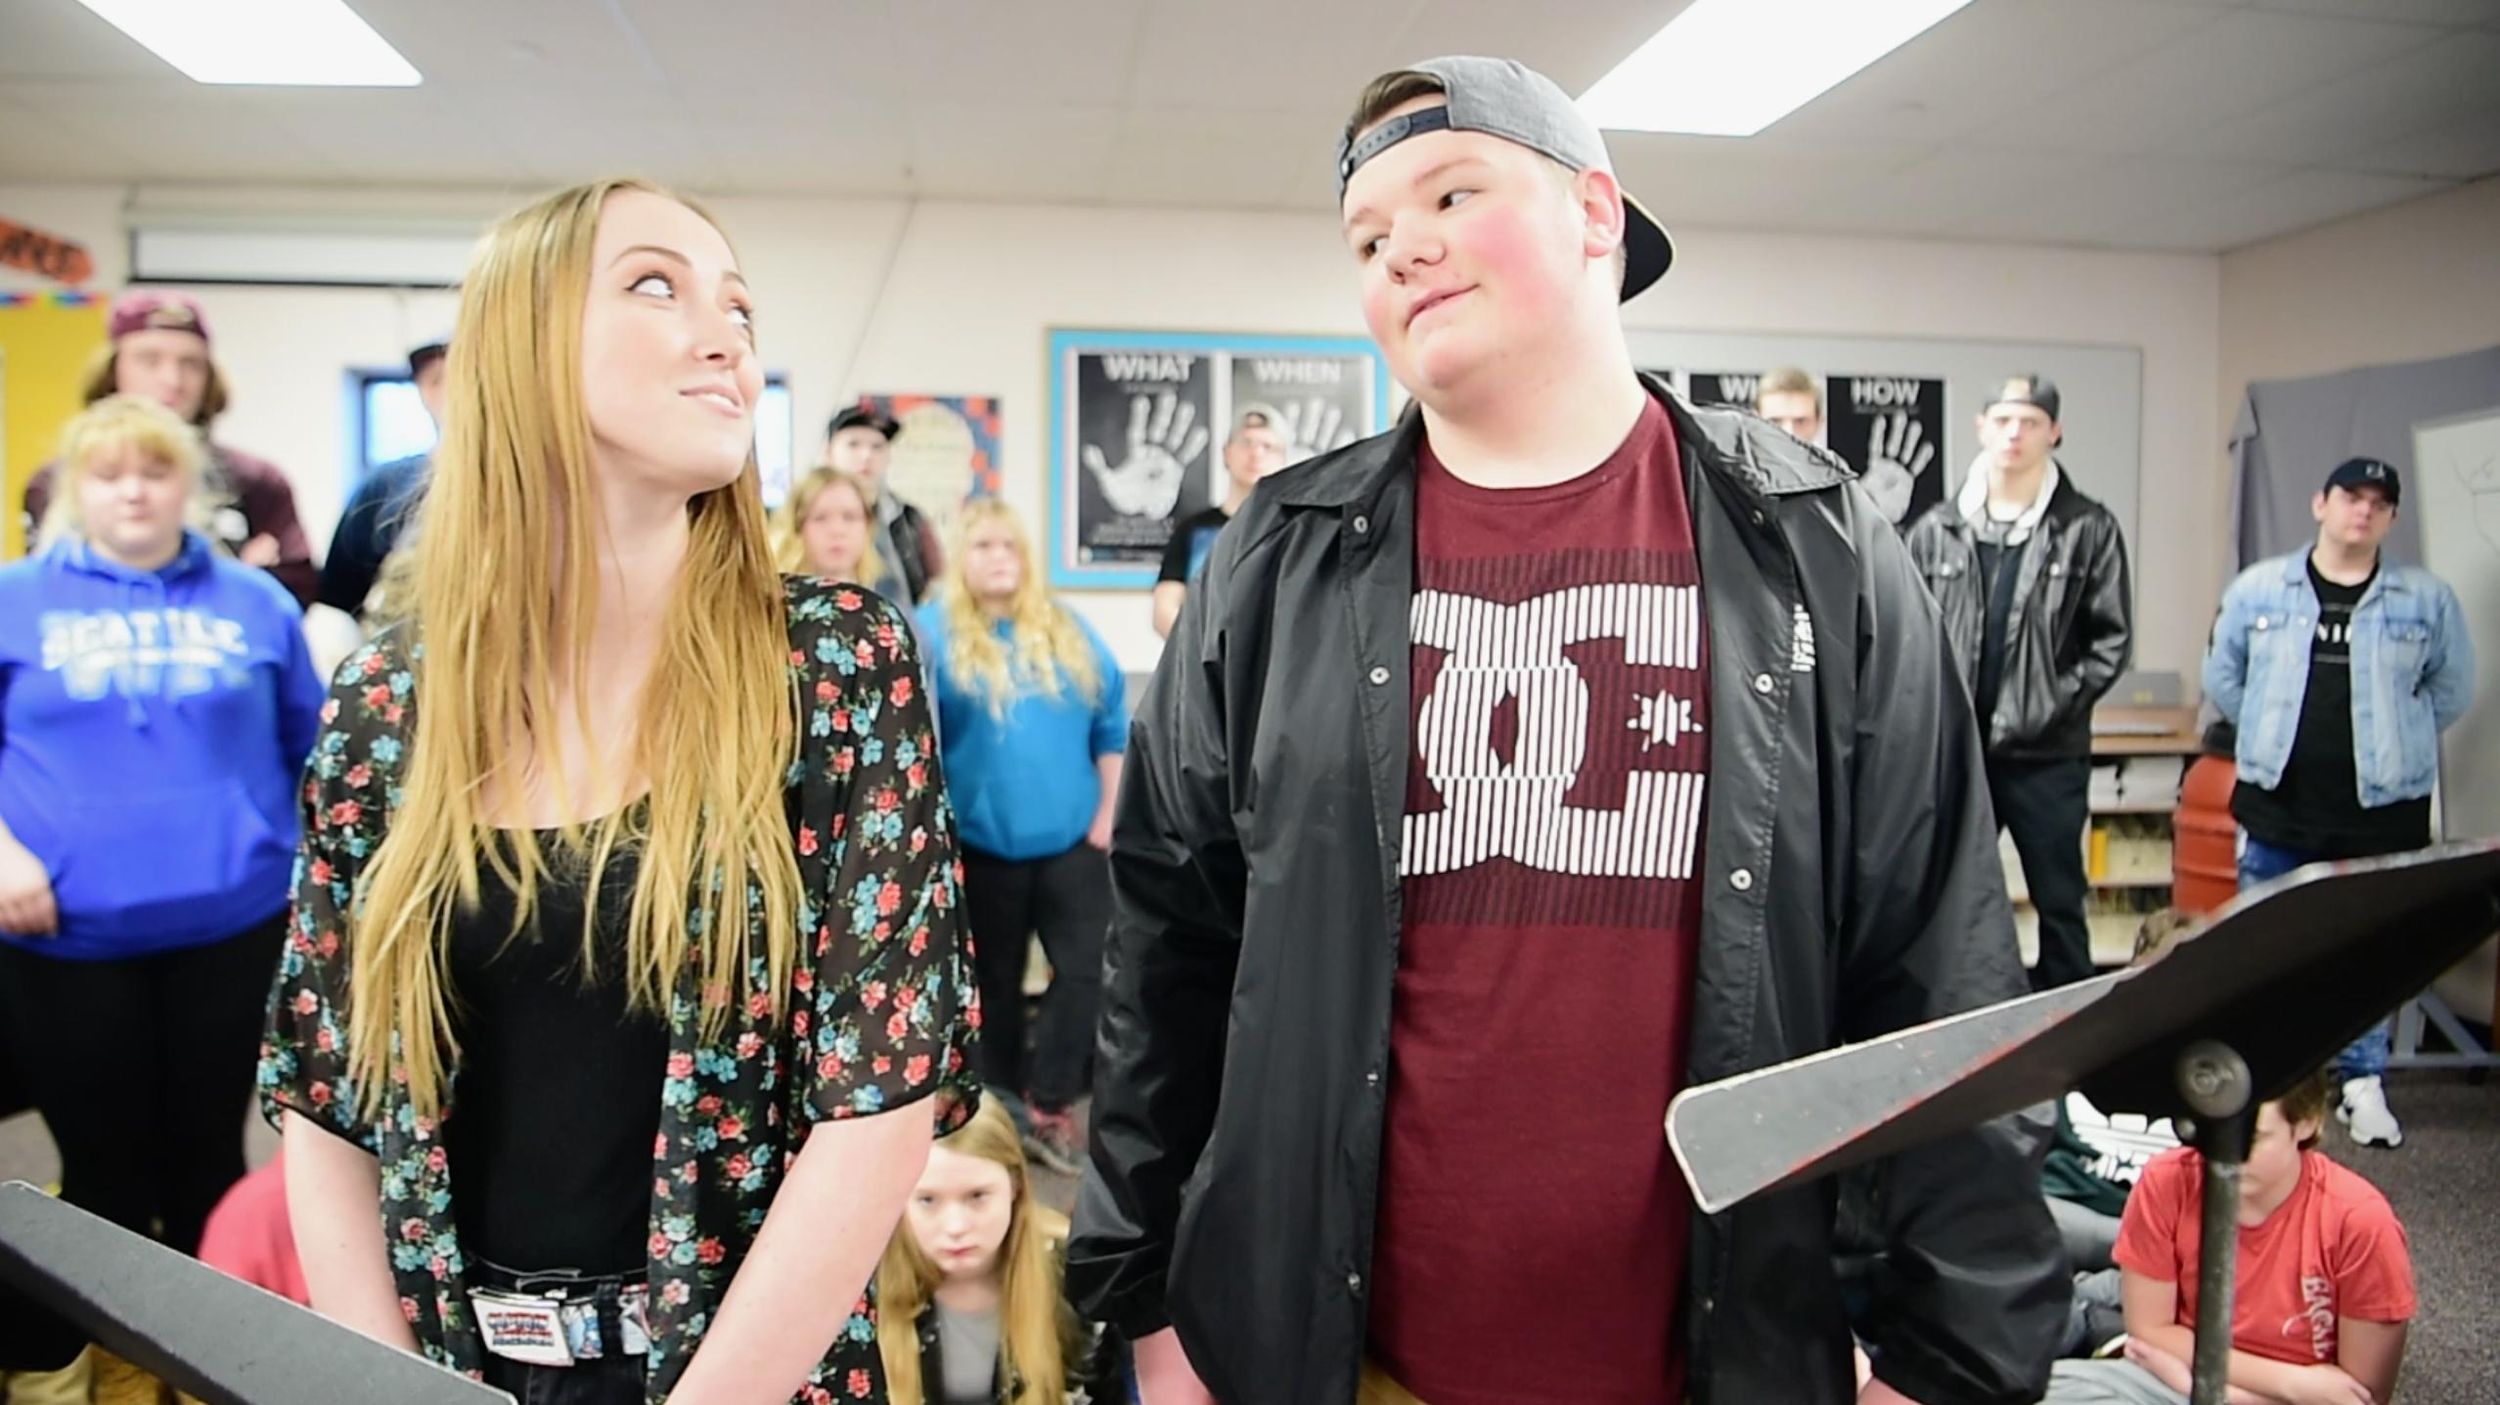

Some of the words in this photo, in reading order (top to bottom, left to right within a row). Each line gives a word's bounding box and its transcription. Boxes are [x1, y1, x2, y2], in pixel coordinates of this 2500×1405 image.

[1102, 355, 1195, 381] WHAT
[1254, 359, 1341, 384] WHEN
[1851, 378, 1921, 406] HOW
[40, 608, 249, 670] SEATTLE
